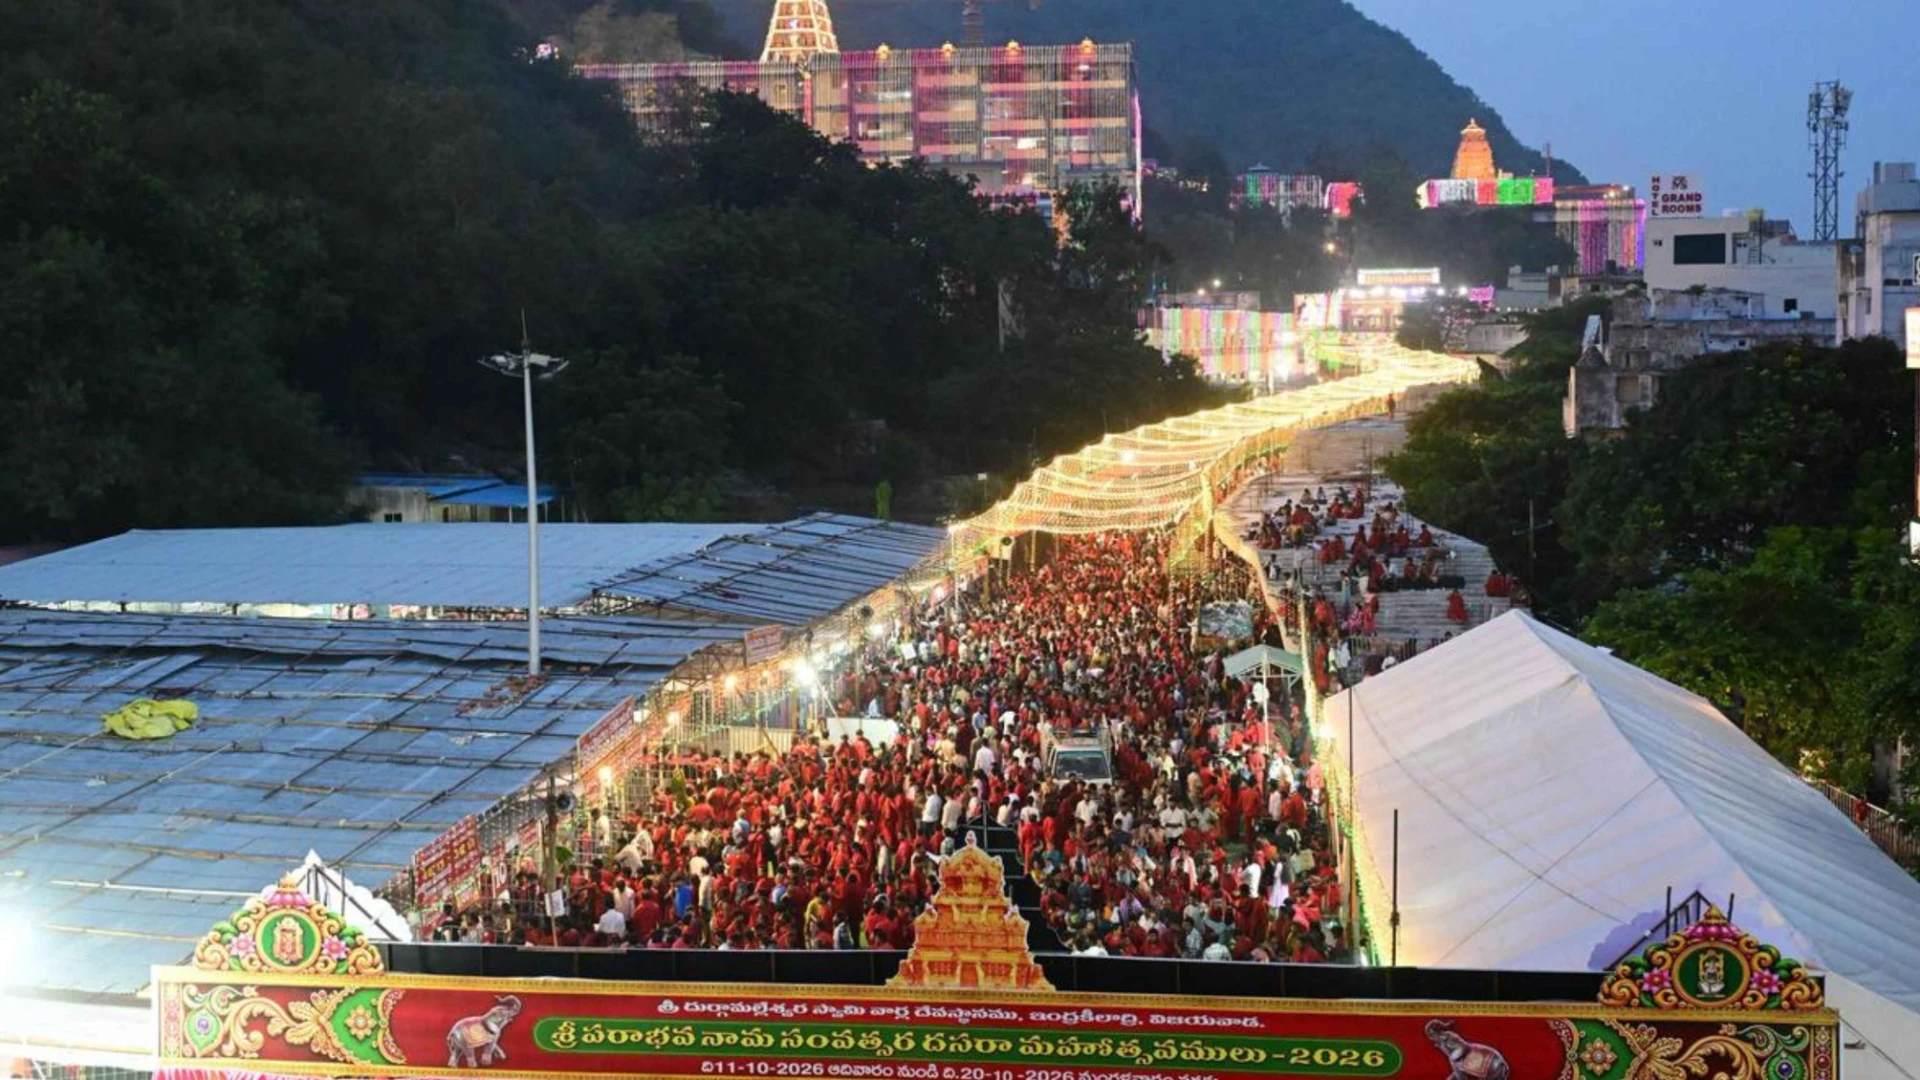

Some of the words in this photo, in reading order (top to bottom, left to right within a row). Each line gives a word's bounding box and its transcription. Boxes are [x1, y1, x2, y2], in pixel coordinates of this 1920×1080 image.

[1651, 176, 1660, 216] HOTEL
[1661, 193, 1702, 202] GRAND
[1661, 204, 1702, 214] ROOMS
[813, 1003, 866, 1019] స్వామి
[552, 1020, 577, 1048] శ్రీ
[581, 1023, 696, 1049] పరాభవ
[701, 1027, 774, 1048] నామ
[781, 1028, 915, 1057] సంవత్సర
[922, 1033, 1013, 1054] దసరా
[827, 1064, 894, 1077] ఆదివారం
[898, 1064, 940, 1079] నుండి
